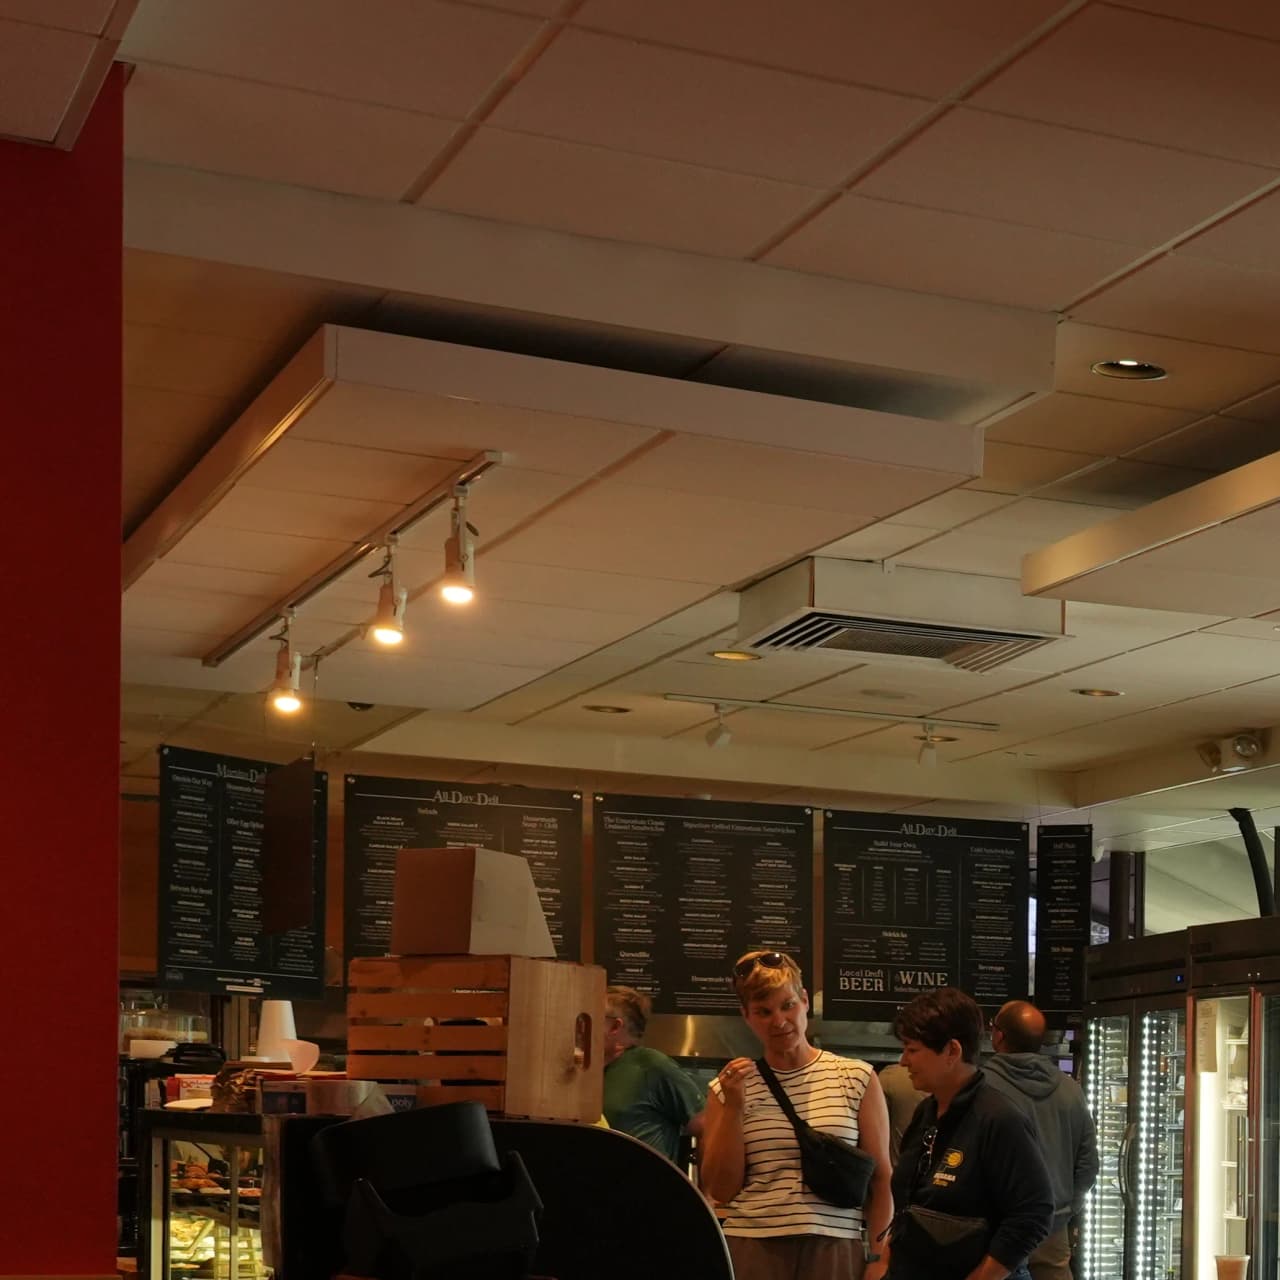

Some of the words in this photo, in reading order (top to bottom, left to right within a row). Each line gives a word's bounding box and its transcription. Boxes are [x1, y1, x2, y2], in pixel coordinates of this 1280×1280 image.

[432, 789, 449, 802] All
[451, 791, 474, 804] Day
[477, 792, 500, 805] Deli
[900, 823, 914, 834] All
[915, 824, 935, 836] Day
[937, 825, 958, 837] Deli
[839, 968, 863, 977] Local
[899, 971, 949, 987] WINE
[839, 977, 884, 992] BEER
